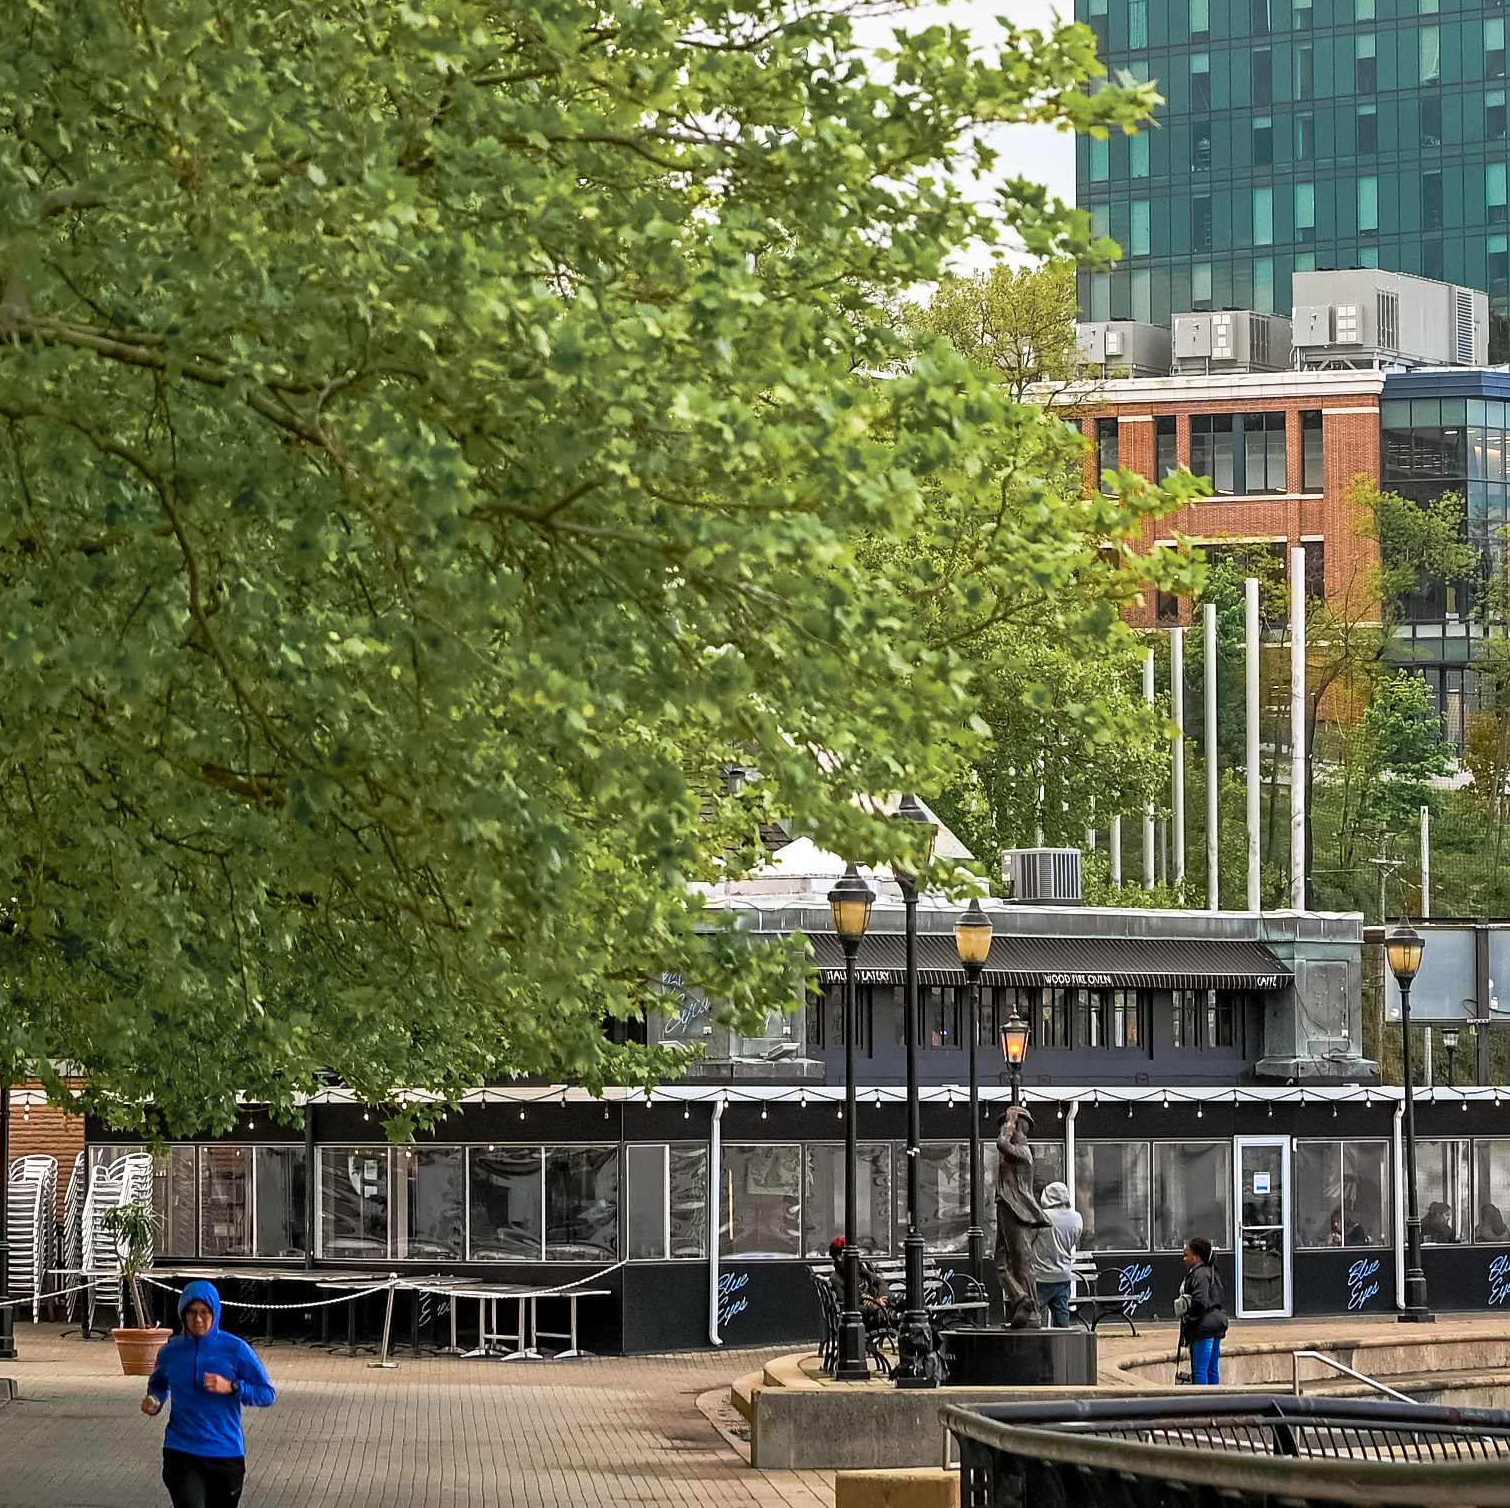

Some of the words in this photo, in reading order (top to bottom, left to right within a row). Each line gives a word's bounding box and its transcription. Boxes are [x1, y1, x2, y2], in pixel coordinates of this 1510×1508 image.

[826, 970, 860, 981] ITALIN
[1043, 974, 1071, 984] WOOD
[1087, 974, 1112, 985] OVEN
[718, 1272, 750, 1299] Blue
[1347, 1258, 1381, 1286] Blue
[1347, 1280, 1381, 1310] Eyes
[718, 1295, 749, 1327] Eyes
